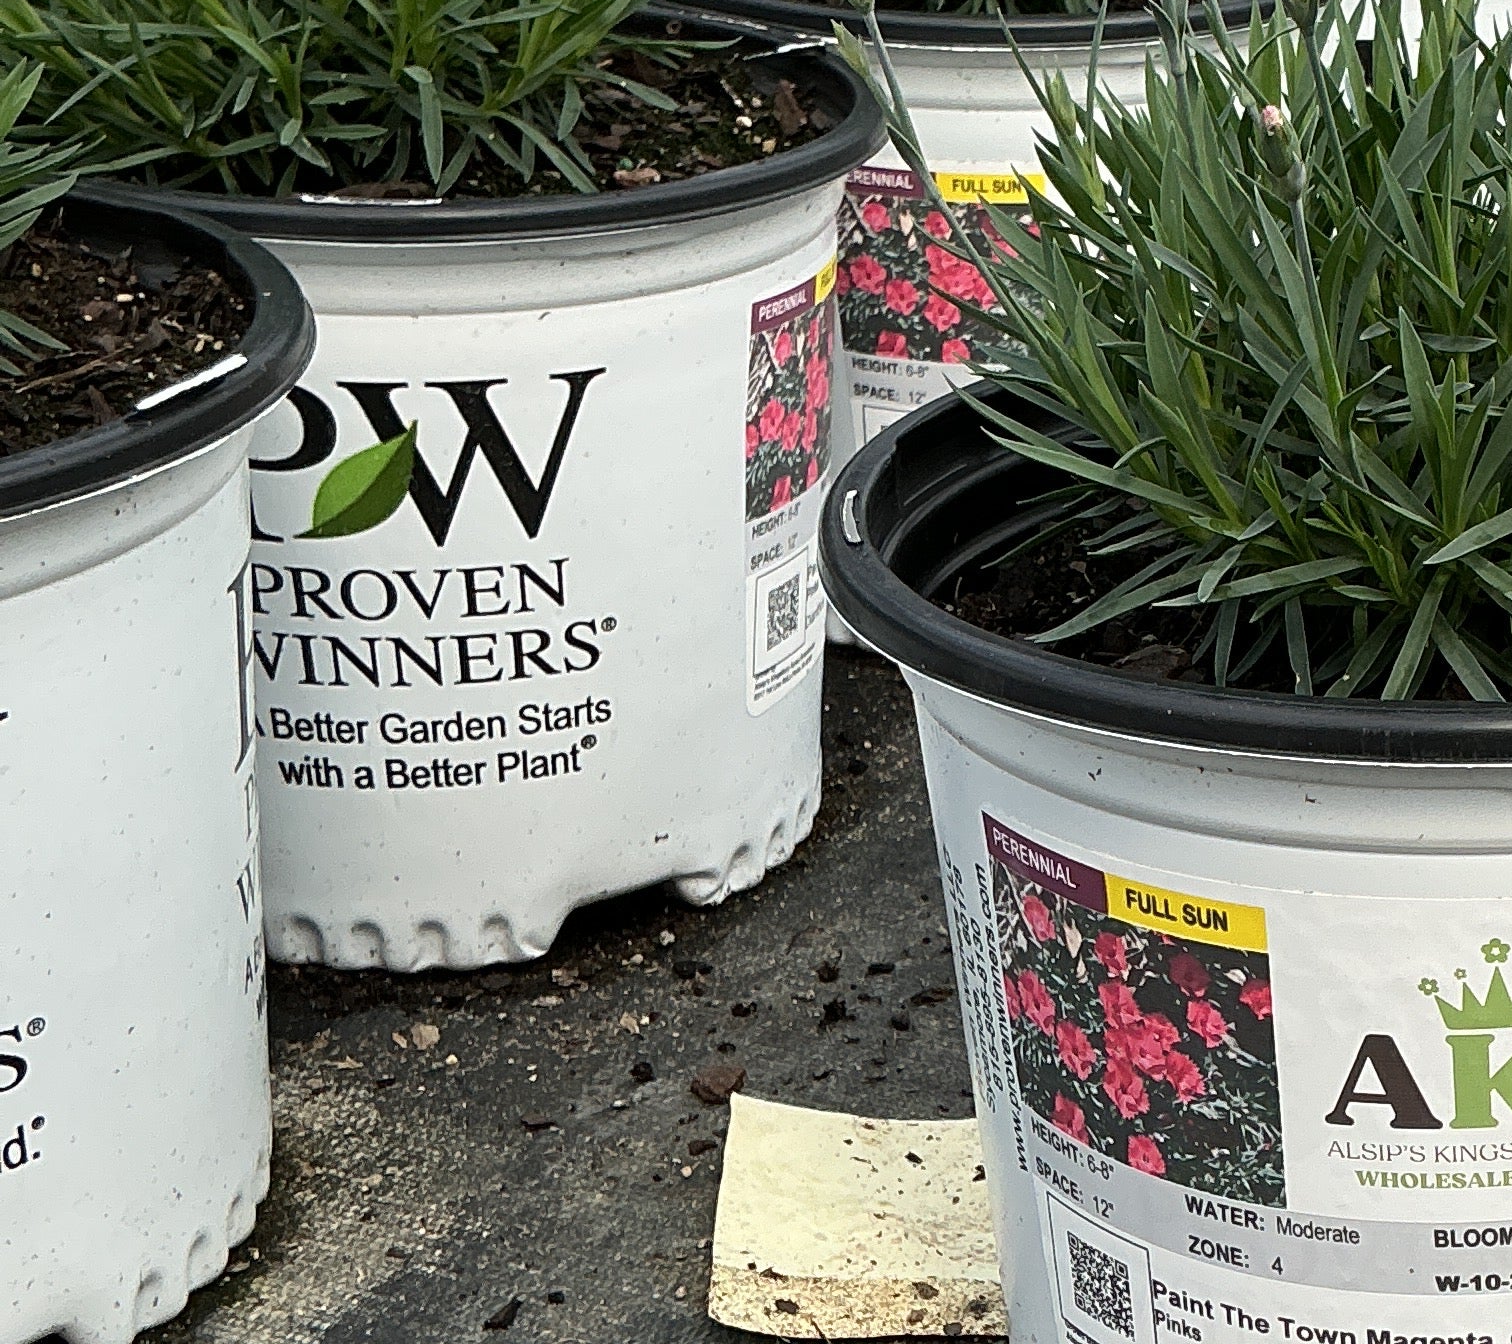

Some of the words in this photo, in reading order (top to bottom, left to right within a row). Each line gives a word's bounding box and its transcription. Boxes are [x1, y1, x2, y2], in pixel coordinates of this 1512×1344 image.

[952, 179, 988, 193] FULL
[992, 179, 1022, 194] SUN
[251, 558, 570, 621] PROVEN
[269, 707, 369, 745] Better
[380, 711, 507, 745] Garden
[518, 696, 613, 735] Starts
[278, 758, 344, 788] with
[354, 764, 375, 790] a
[385, 757, 488, 790] Better
[992, 826, 1077, 889] PERENNIAL
[1125, 887, 1178, 923] FULL
[1182, 903, 1229, 933] SUN
[974, 862, 1028, 1172] www.provenwinners.com
[1030, 1116, 1084, 1168] HEIGHT:
[1086, 1153, 1116, 1182] 6-8"
[1327, 1139, 1426, 1164] ALSIP'S
[1035, 1155, 1084, 1205] SPACE:
[1092, 1195, 1116, 1220] 12"
[1184, 1193, 1266, 1233] WATER:
[1275, 1215, 1362, 1246] Moderate
[1187, 1233, 1250, 1270] ZONE:
[1271, 1255, 1285, 1276] 4
[1151, 1278, 1216, 1322] Paint
[1219, 1302, 1272, 1335] The
[1153, 1307, 1203, 1343] Pinks
